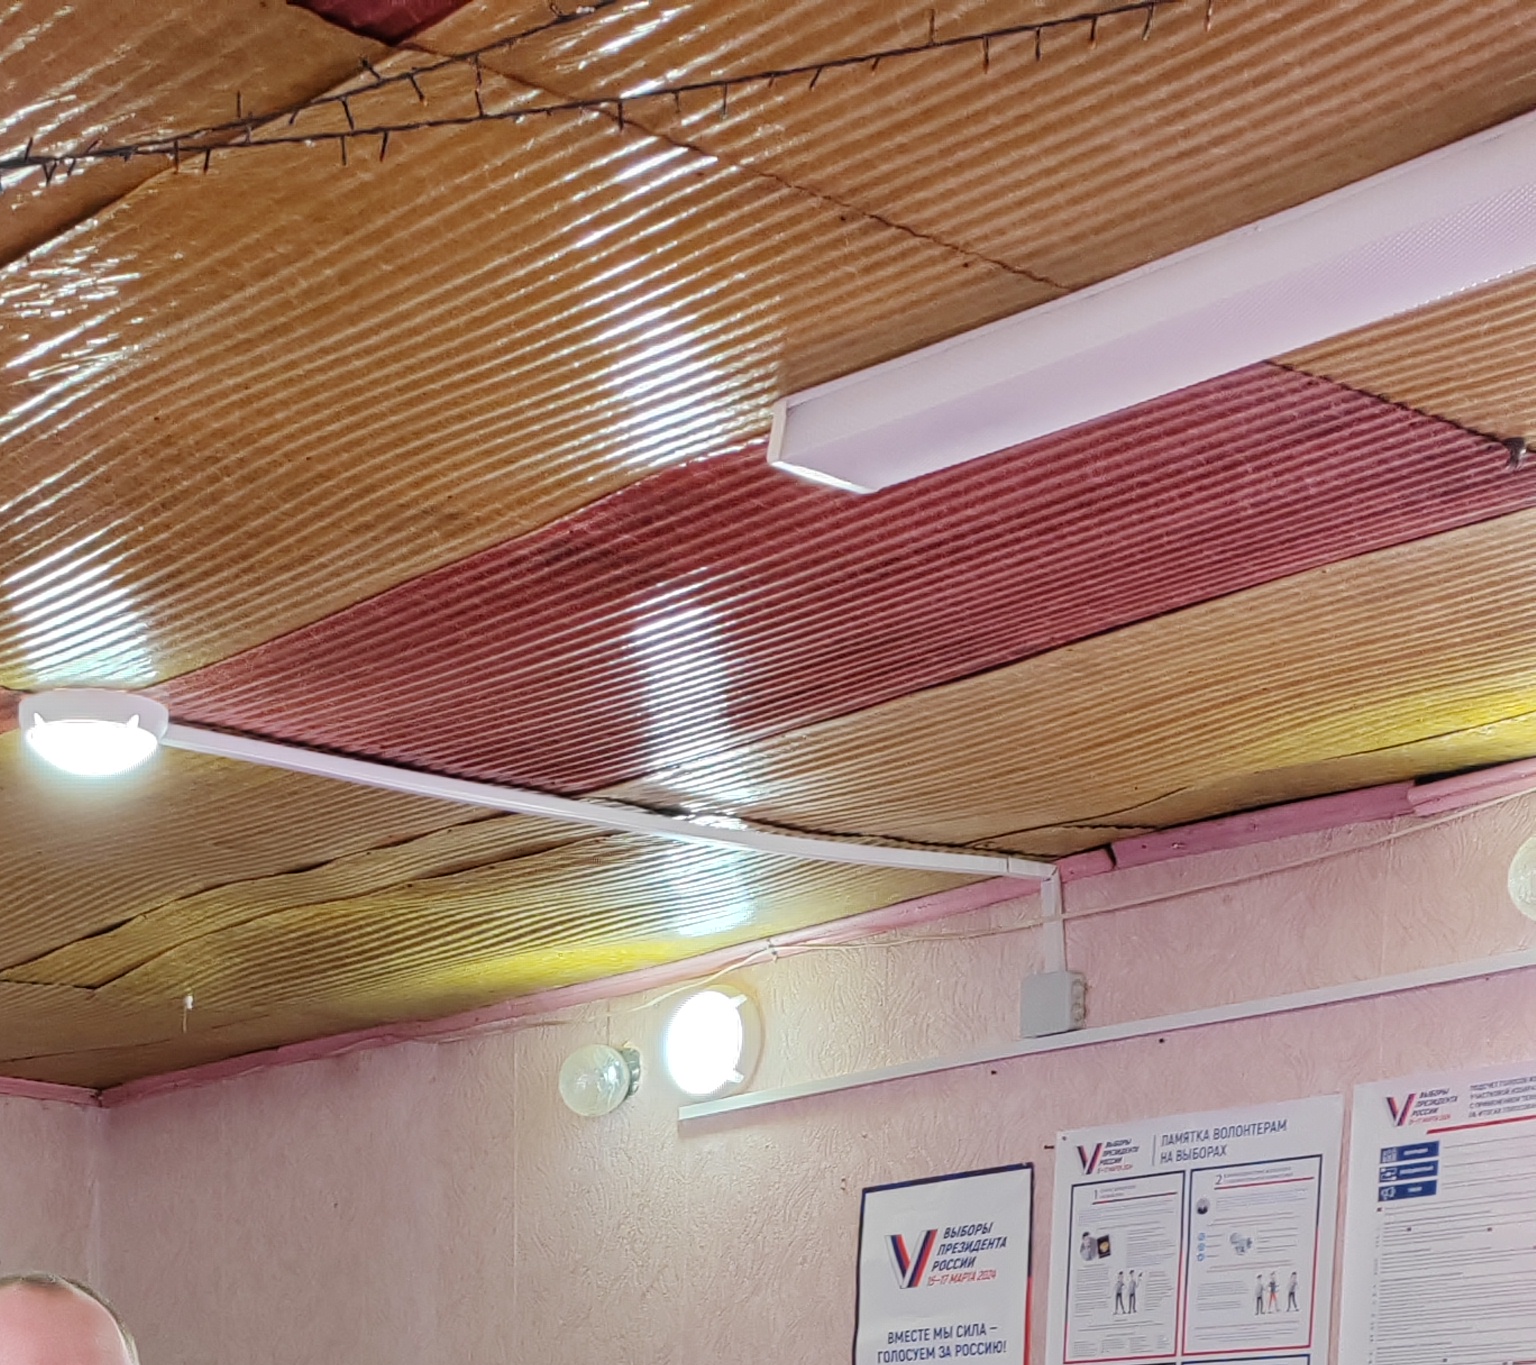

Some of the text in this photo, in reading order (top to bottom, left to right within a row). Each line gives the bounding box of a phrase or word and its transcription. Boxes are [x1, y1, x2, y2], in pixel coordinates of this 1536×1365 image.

[1161, 1119, 1287, 1147] ПАМЯТКА ВОЛОНТЕРАМ
[1160, 1144, 1227, 1164] НА ВЫБОРАХ
[1215, 1174, 1223, 1185] 2
[943, 1221, 994, 1240] ВЫБОРЫ
[937, 1237, 1008, 1256] ПРЕЗИДЕНТА
[931, 1256, 977, 1272] РОССИИ
[887, 1327, 930, 1345] ВМЕСТЕ
[933, 1326, 953, 1340] МЫ
[956, 1323, 986, 1338] СИЛА
[877, 1340, 1007, 1364] ГОЛОСУЕМ ЗА РОССИЮ!
